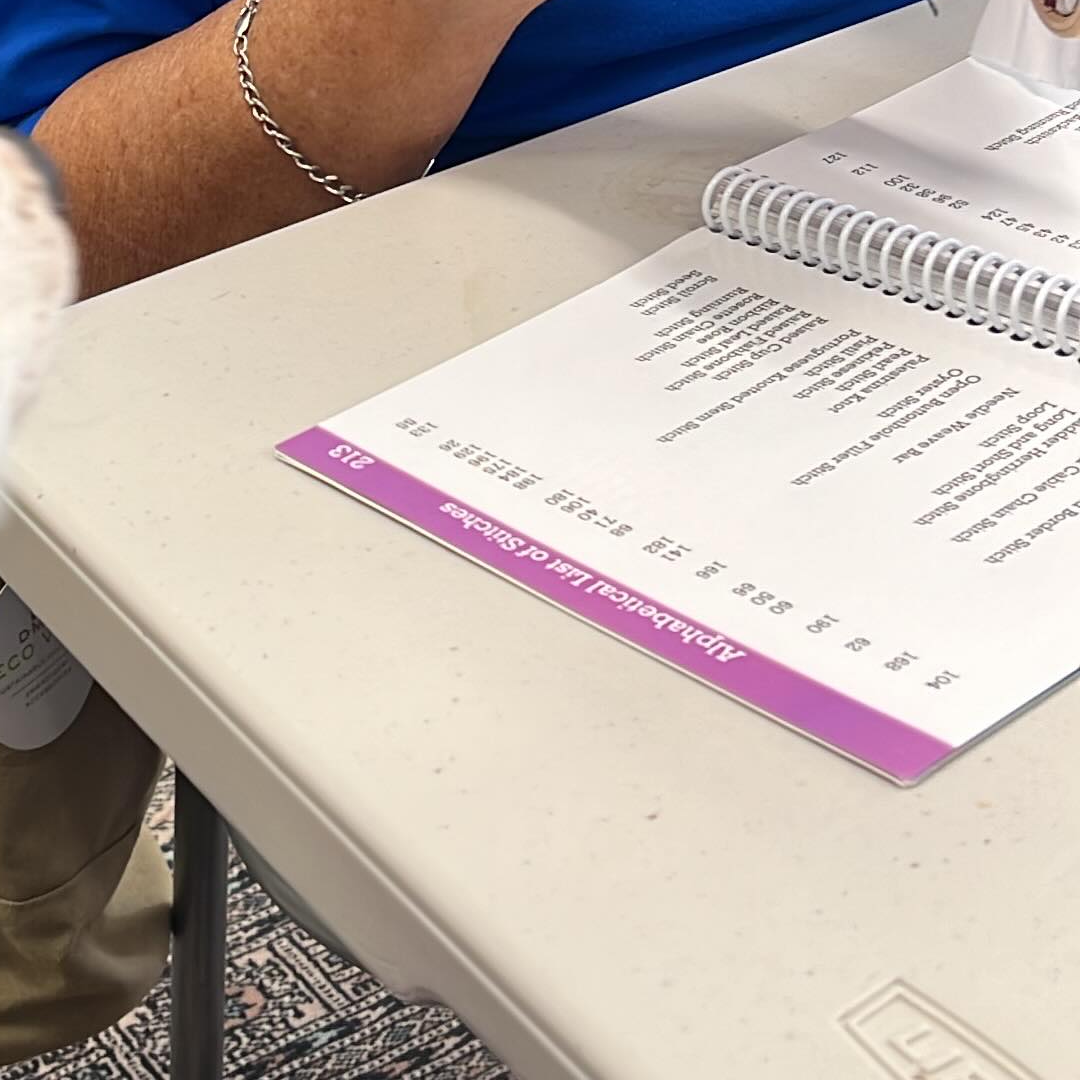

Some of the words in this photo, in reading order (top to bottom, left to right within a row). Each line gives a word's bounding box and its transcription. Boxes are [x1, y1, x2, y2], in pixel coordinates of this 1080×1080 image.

[1016, 109, 1071, 135] Running
[984, 134, 1022, 150] Stitch
[822, 152, 847, 164] 127
[851, 164, 878, 175] 112
[884, 175, 910, 186] 100
[900, 183, 920, 192] 32
[981, 208, 1008, 220] 124
[1000, 218, 1017, 226] 47
[1033, 229, 1052, 237] 43
[1050, 235, 1069, 243] 42
[666, 270, 702, 290] Seed
[677, 276, 718, 297] Scroll
[630, 288, 670, 307] Stitch
[641, 296, 681, 315] Stitch
[688, 287, 749, 318] Running
[713, 293, 764, 320] Rosette
[728, 299, 780, 326] Ribbon
[746, 305, 796, 331] Raised
[654, 317, 694, 337] Stitch
[672, 321, 715, 342] Chain
[762, 310, 812, 338] Raised
[778, 316, 829, 344] Raised
[696, 326, 733, 344] Rose
[718, 330, 752, 349] Leaf
[840, 335, 878, 356] Pistil
[635, 342, 677, 362] Stitch
[680, 346, 722, 367] Stitch
[703, 336, 768, 370] Fishbone
[750, 344, 782, 360] Cup
[783, 329, 862, 372] Portuguese
[831, 342, 896, 377] Pekinese
[872, 348, 913, 371] Pearl
[712, 360, 754, 380] Stitch
[803, 355, 846, 376] Stitch
[860, 354, 930, 393] Palestrina
[664, 370, 707, 391] Stitch
[730, 372, 788, 403] Knotted
[793, 377, 836, 399] Stitch
[834, 369, 877, 391] Stitch
[915, 369, 963, 396] Oyster
[939, 376, 981, 398] Open
[695, 402, 735, 421] Stem
[828, 393, 866, 413] Knot
[877, 396, 920, 418] Stitch
[965, 388, 1020, 419] Needle
[1016, 402, 1058, 424] Loop
[869, 398, 946, 441] Buttonhole
[1033, 408, 1077, 432] Long
[656, 421, 700, 442] Stitch
[918, 421, 971, 448] Weave
[978, 424, 1022, 447] Stitch
[1008, 432, 1038, 450] and
[328, 444, 375, 469] 213
[832, 440, 874, 464] Filler
[892, 448, 924, 464] Bar
[970, 448, 1014, 472] Short
[790, 462, 836, 485] Stitch
[931, 472, 976, 495] Stitch
[954, 448, 1047, 502] Herringbone
[1034, 466, 1080, 492] Cable
[544, 489, 574, 505] 180
[990, 493, 1038, 518] Chain
[578, 510, 598, 520] 40
[594, 516, 618, 528] 71
[913, 502, 960, 525] Stitch
[1025, 508, 1079, 539] Border
[439, 502, 526, 551] Stitches
[950, 518, 998, 542] Stitch
[515, 545, 549, 563] of
[642, 536, 674, 554] 182
[661, 545, 692, 561] 141
[984, 538, 1031, 563] Stitch
[545, 559, 593, 587] List
[768, 601, 793, 614] 60
[585, 582, 747, 662] Alphabetical
[806, 614, 839, 633] 190
[844, 638, 871, 652] 62
[884, 651, 918, 671] 168
[924, 670, 960, 689] 104
